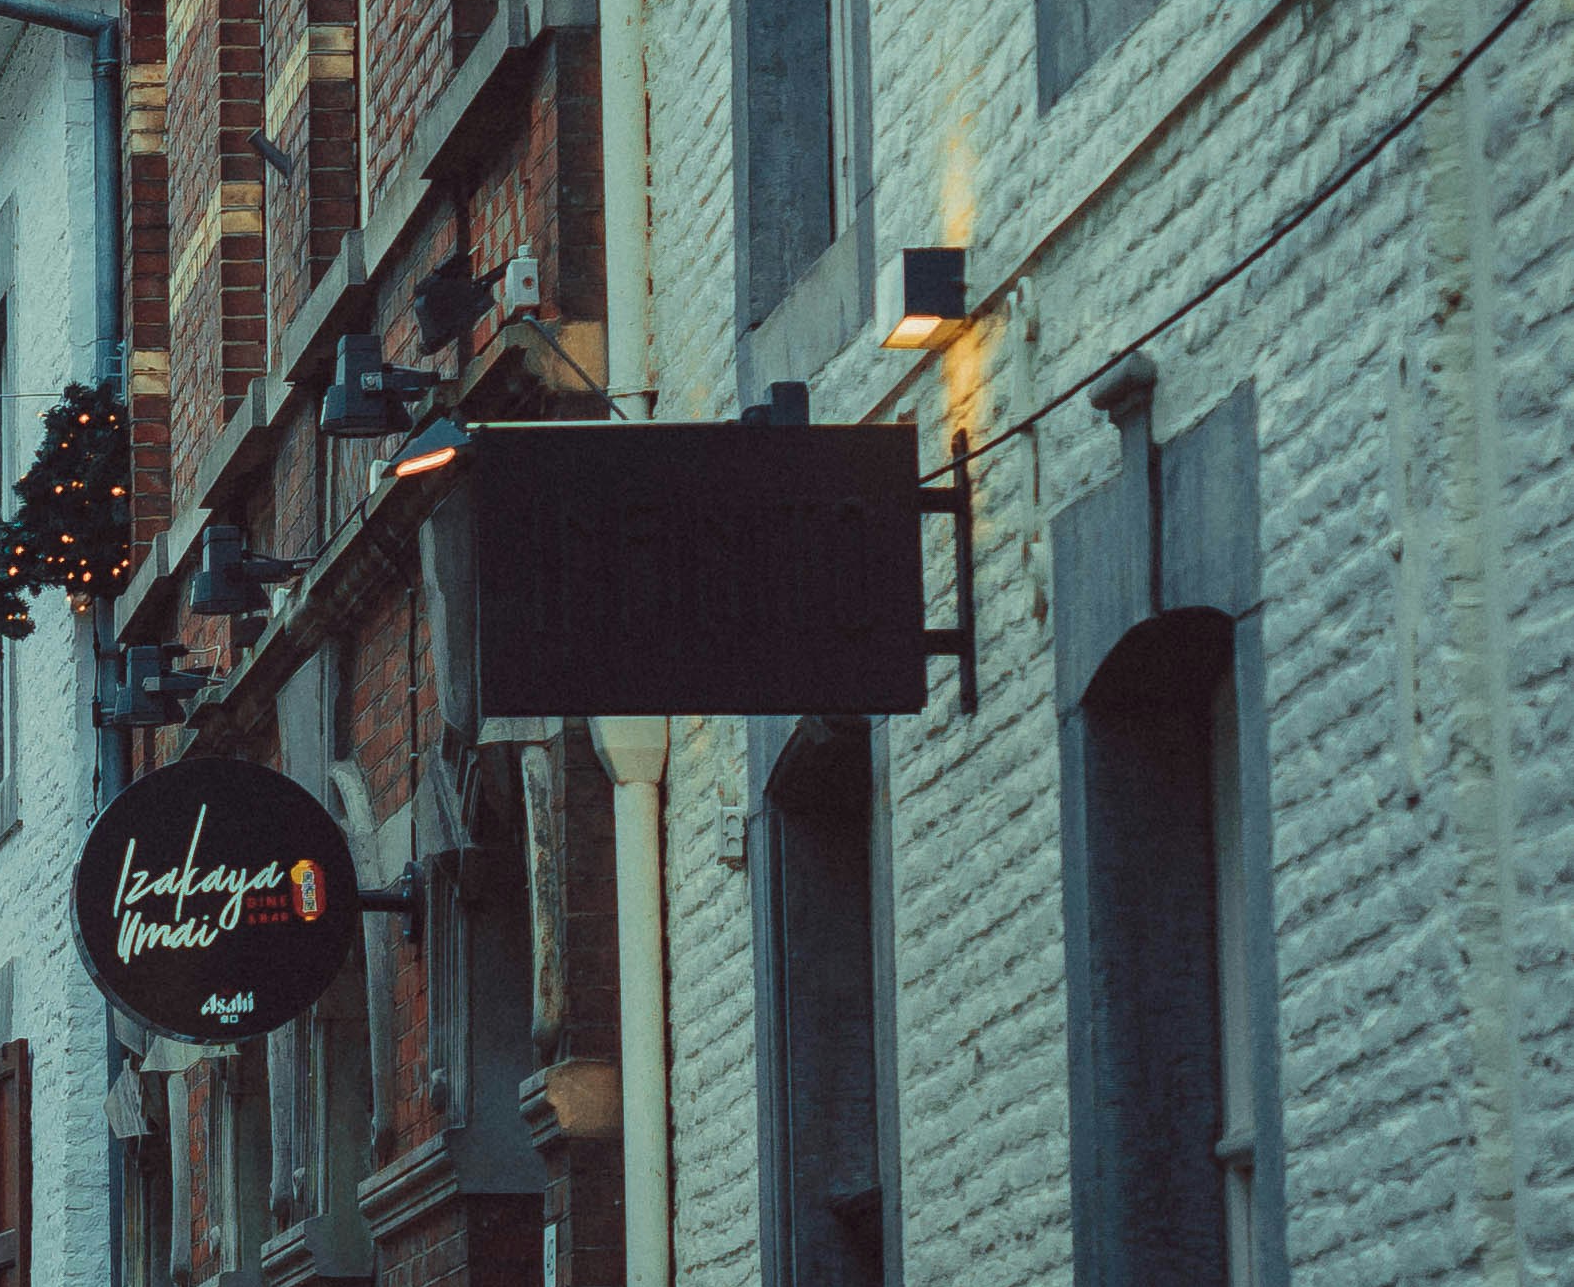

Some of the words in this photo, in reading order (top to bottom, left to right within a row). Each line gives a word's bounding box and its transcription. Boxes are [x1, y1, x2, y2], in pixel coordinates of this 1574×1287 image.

[113, 803, 284, 931] Izakaya
[115, 907, 219, 964] Umai
[200, 990, 255, 1016] Asahi
